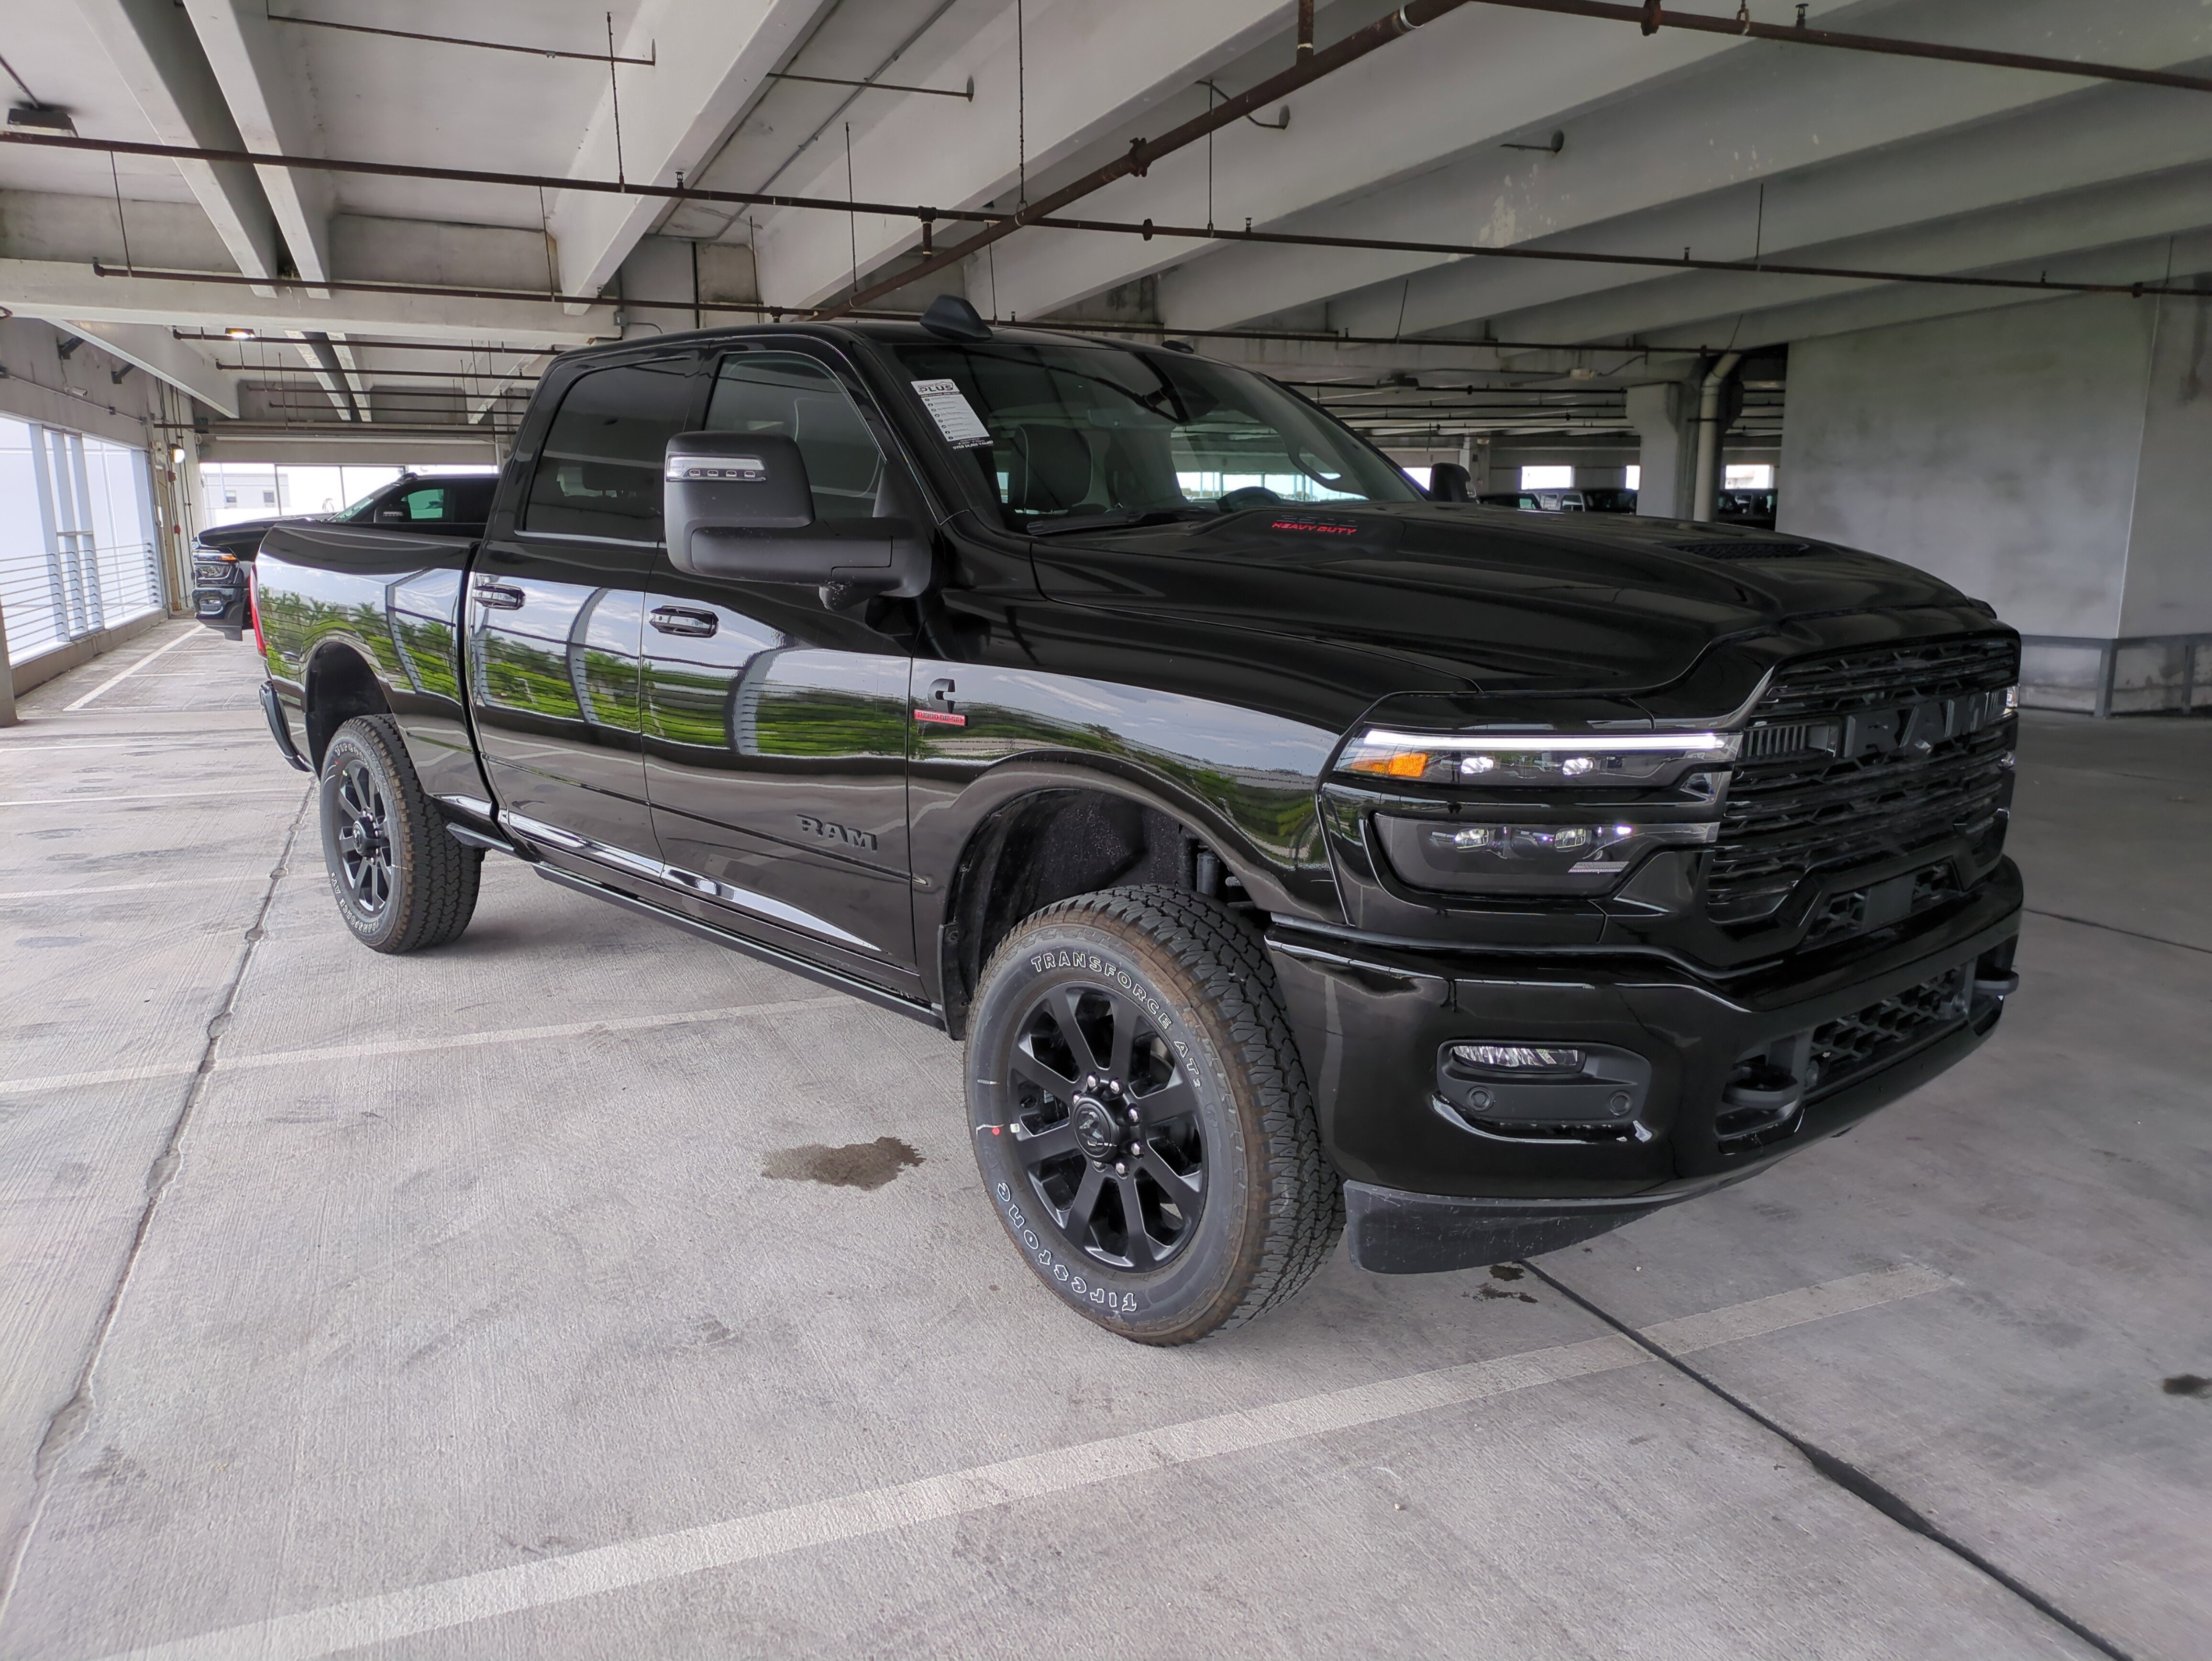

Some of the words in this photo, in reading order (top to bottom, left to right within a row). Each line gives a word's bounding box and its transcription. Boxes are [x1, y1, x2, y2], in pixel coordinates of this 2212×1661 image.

[1271, 521, 1316, 531] HEAVY
[1317, 526, 1357, 535] DUTY
[796, 814, 878, 851] RAM
[1030, 951, 1173, 1030] TRANSFORCE
